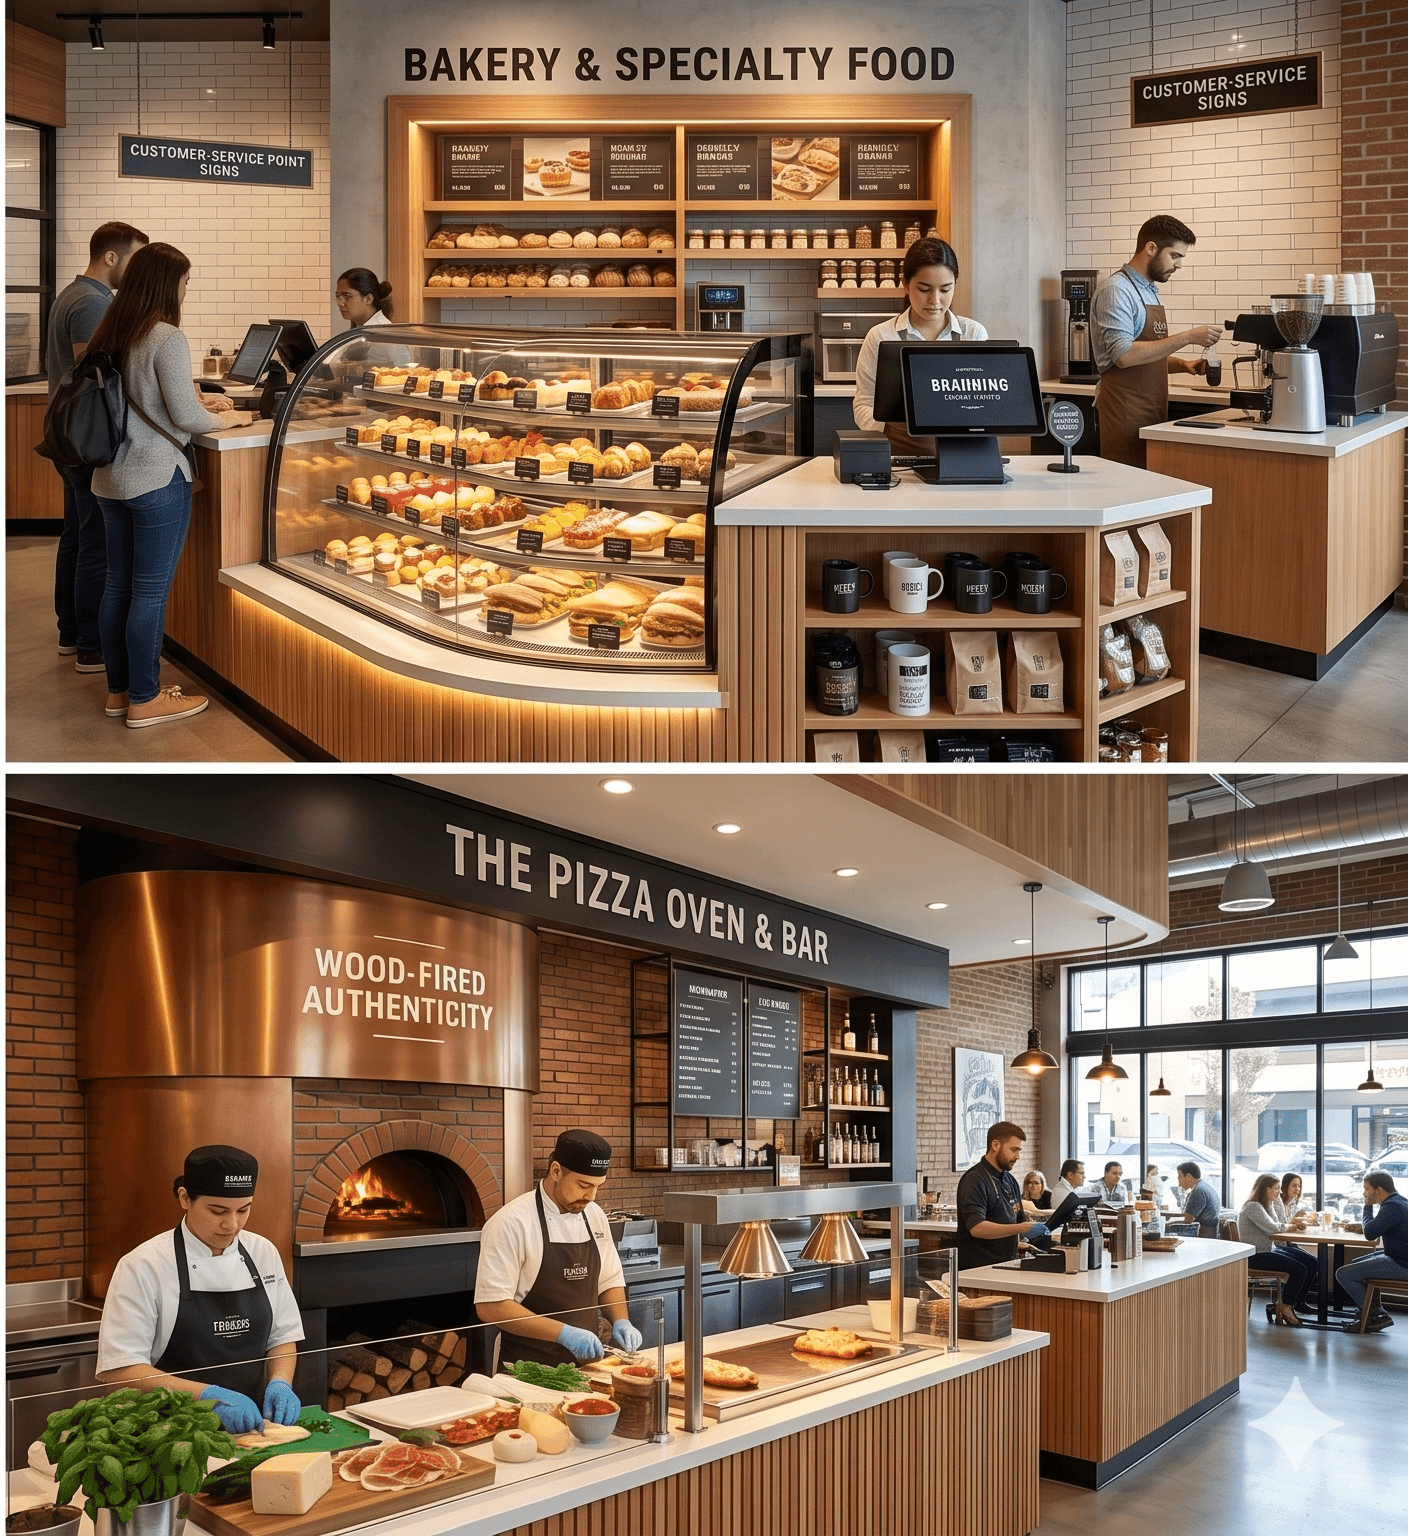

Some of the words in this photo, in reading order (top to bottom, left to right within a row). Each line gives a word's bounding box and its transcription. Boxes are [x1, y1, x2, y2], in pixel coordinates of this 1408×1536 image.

[405, 47, 561, 81] BAKERY
[575, 47, 601, 82] &
[615, 47, 833, 81] SPECIALTY
[848, 47, 955, 81] FOOD
[1142, 65, 1307, 100] CUSTOMER-SERVICE
[1197, 91, 1248, 111] SIGNS
[130, 144, 264, 166] CUSTOMER-SERVICE
[267, 154, 306, 168] POINT
[199, 163, 239, 177] SIGNS
[445, 823, 533, 893] THE
[548, 853, 655, 923] PIZZA
[666, 889, 744, 944] OVEN
[754, 913, 773, 951] &
[781, 919, 830, 965] BAR
[314, 947, 486, 996] WOOD-FIRED
[301, 985, 494, 1031] AUTHENTICITY
